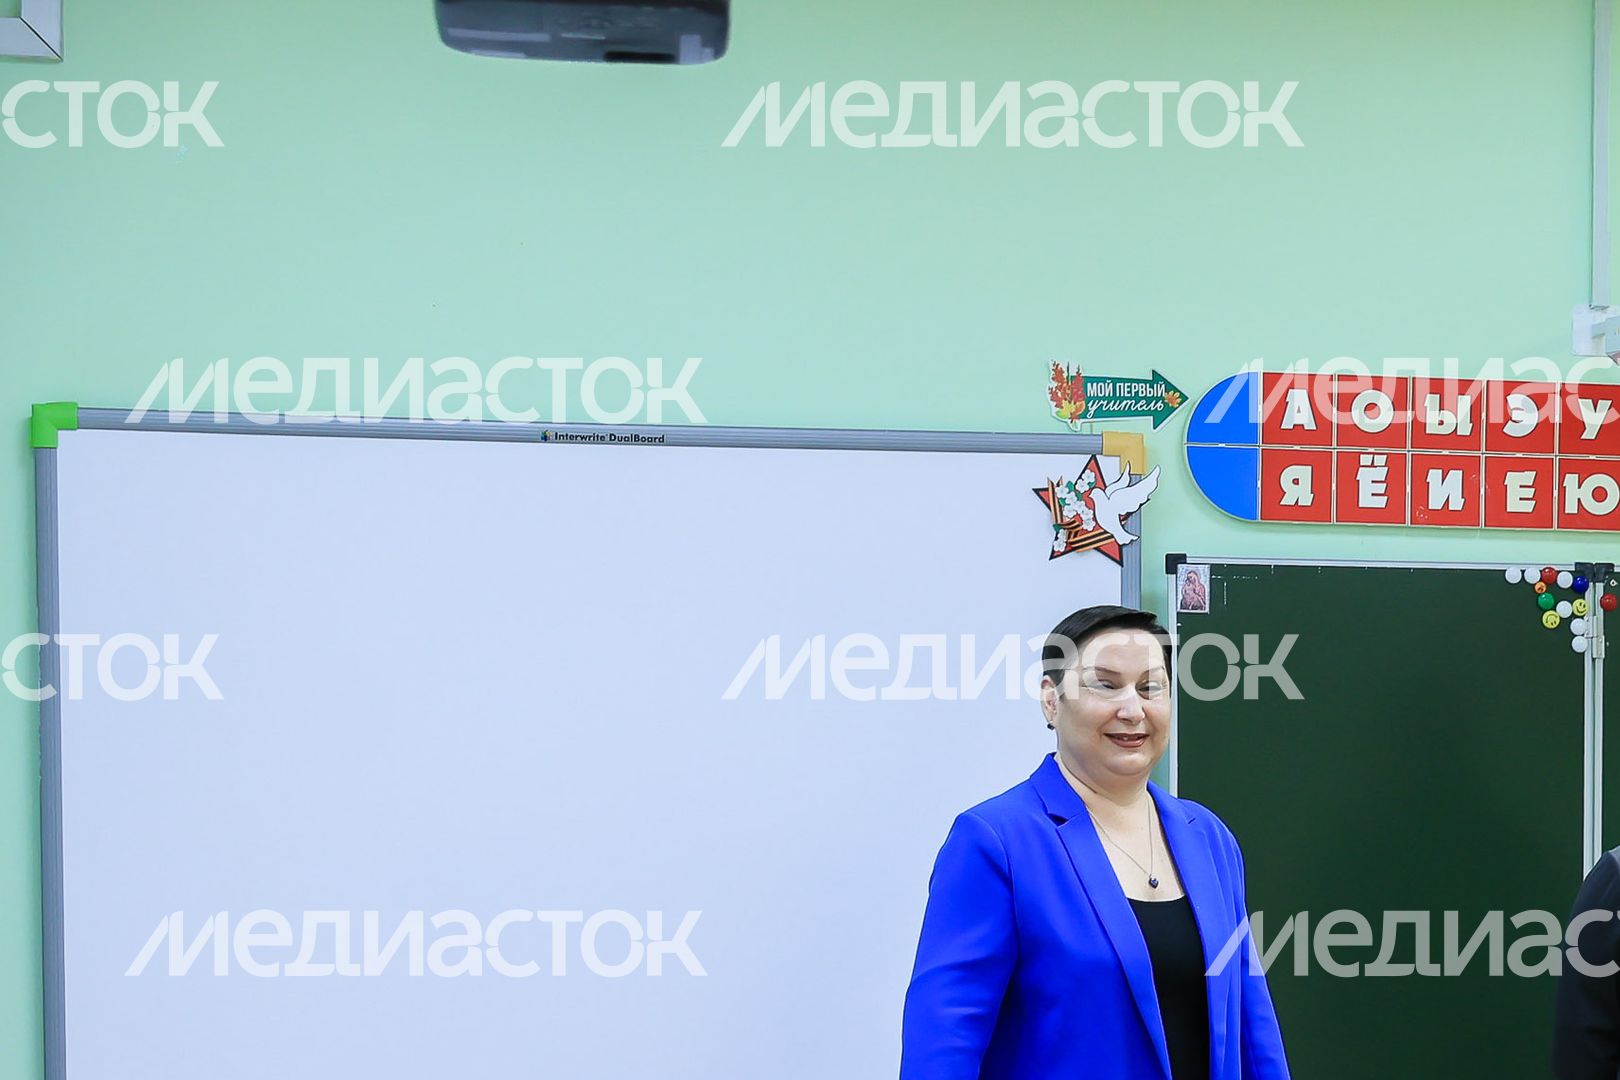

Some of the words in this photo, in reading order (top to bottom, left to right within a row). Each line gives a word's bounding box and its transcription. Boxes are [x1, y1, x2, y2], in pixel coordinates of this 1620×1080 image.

[1087, 380, 1113, 397] МОЙ
[1116, 381, 1165, 397] ПЕРВЫЙ
[1087, 399, 1165, 418] учитель
[1280, 390, 1316, 431] А
[1352, 391, 1390, 433] О
[1425, 394, 1474, 435] Ы
[1503, 394, 1539, 437] Э
[1576, 398, 1614, 440] У
[554, 431, 606, 442] Interwrite
[609, 432, 665, 444] DualBoard
[1279, 465, 1316, 506] Я
[1356, 453, 1390, 510] Ё
[1426, 468, 1467, 511] И
[1504, 471, 1538, 514] Е
[1563, 473, 1620, 515] Ю
